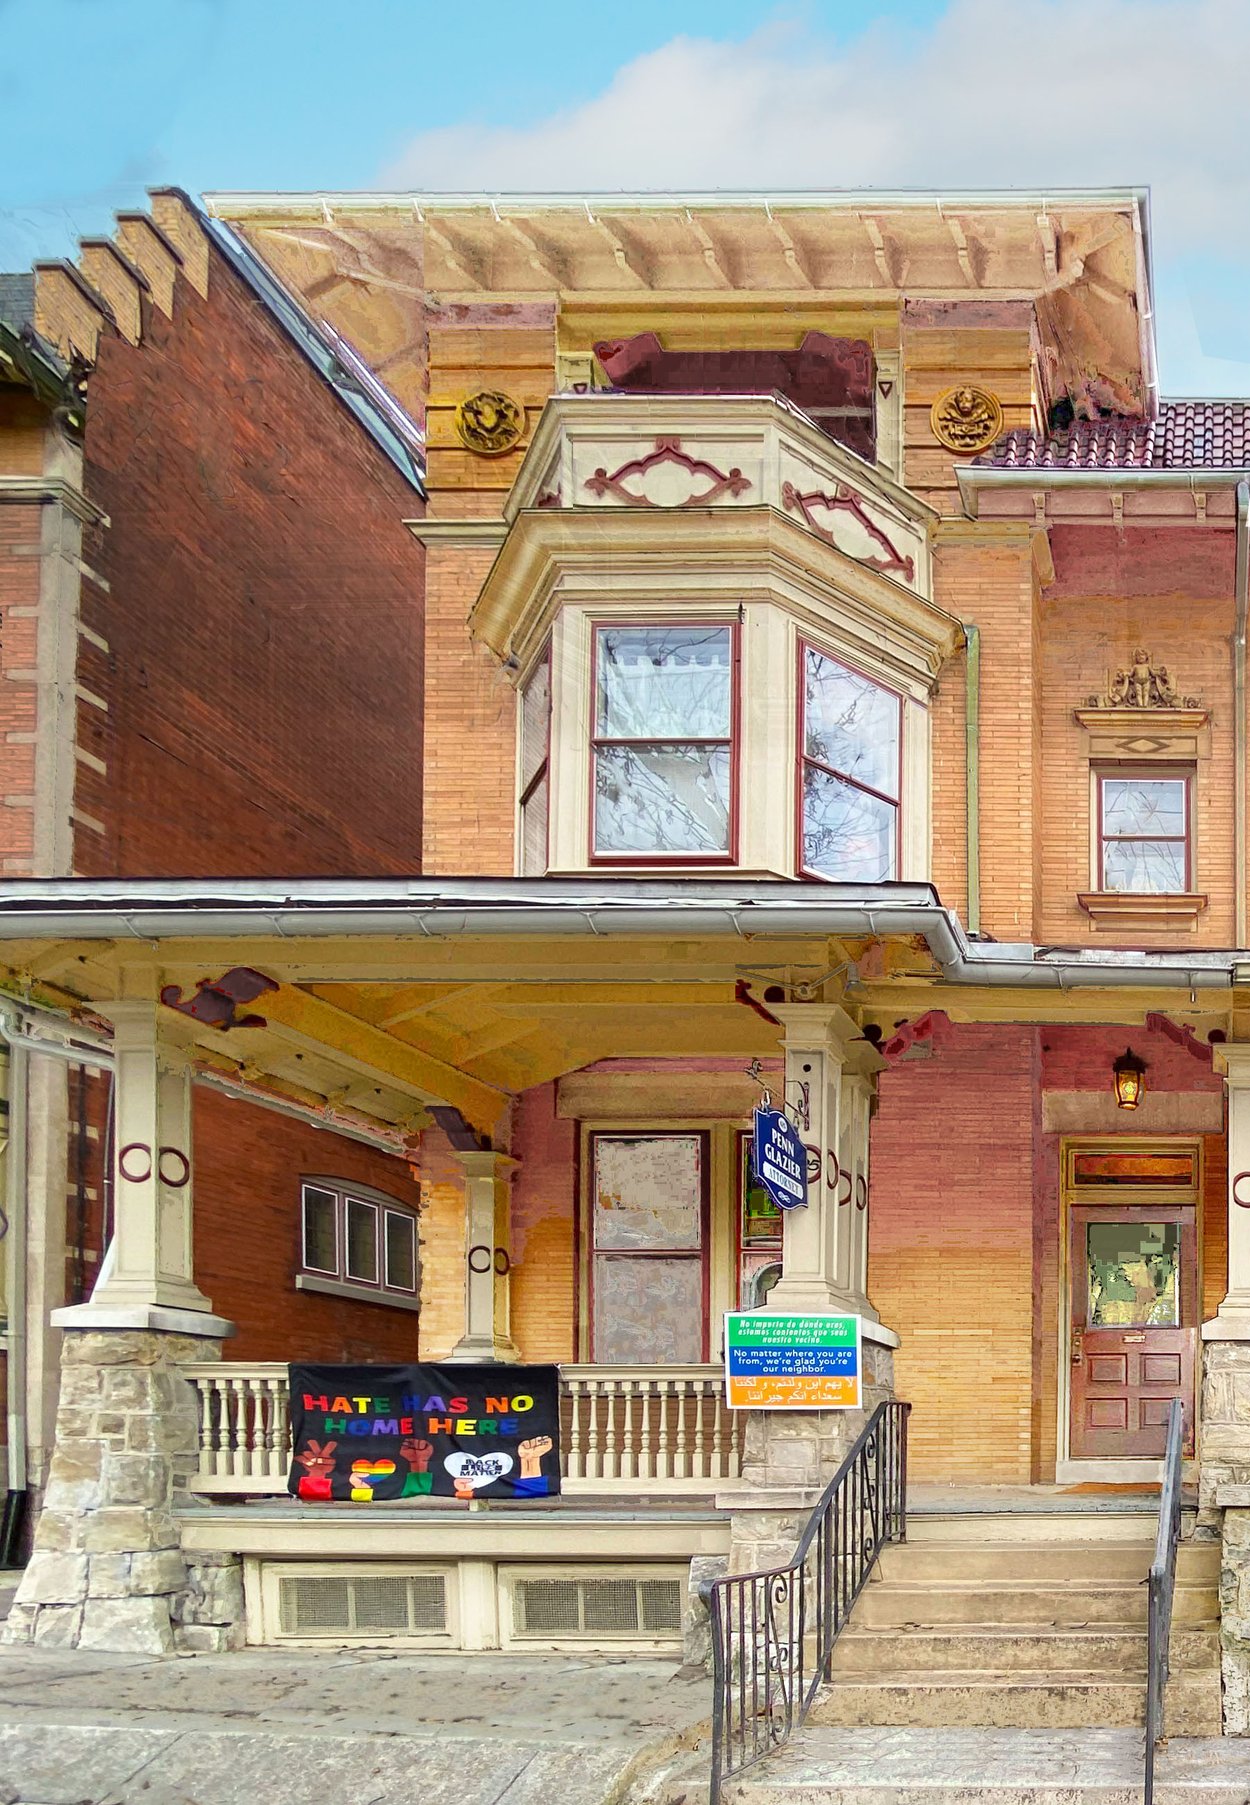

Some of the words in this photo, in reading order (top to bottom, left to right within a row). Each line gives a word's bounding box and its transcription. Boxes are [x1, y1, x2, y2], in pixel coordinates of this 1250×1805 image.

[771, 1128, 795, 1157] PENN
[765, 1143, 801, 1180] GLAZIER
[740, 1320, 750, 1328] No
[787, 1319, 796, 1328] de
[813, 1329, 828, 1337] que
[817, 1351, 833, 1360] you
[738, 1357, 763, 1365] from,
[794, 1358, 815, 1366] glad
[819, 1358, 848, 1366] you're
[782, 1365, 826, 1374] neighbor.
[303, 1394, 391, 1414] HATE
[403, 1395, 468, 1414] HAS
[485, 1395, 534, 1414] NO
[325, 1417, 413, 1436] HOME
[429, 1418, 519, 1436] HERE
